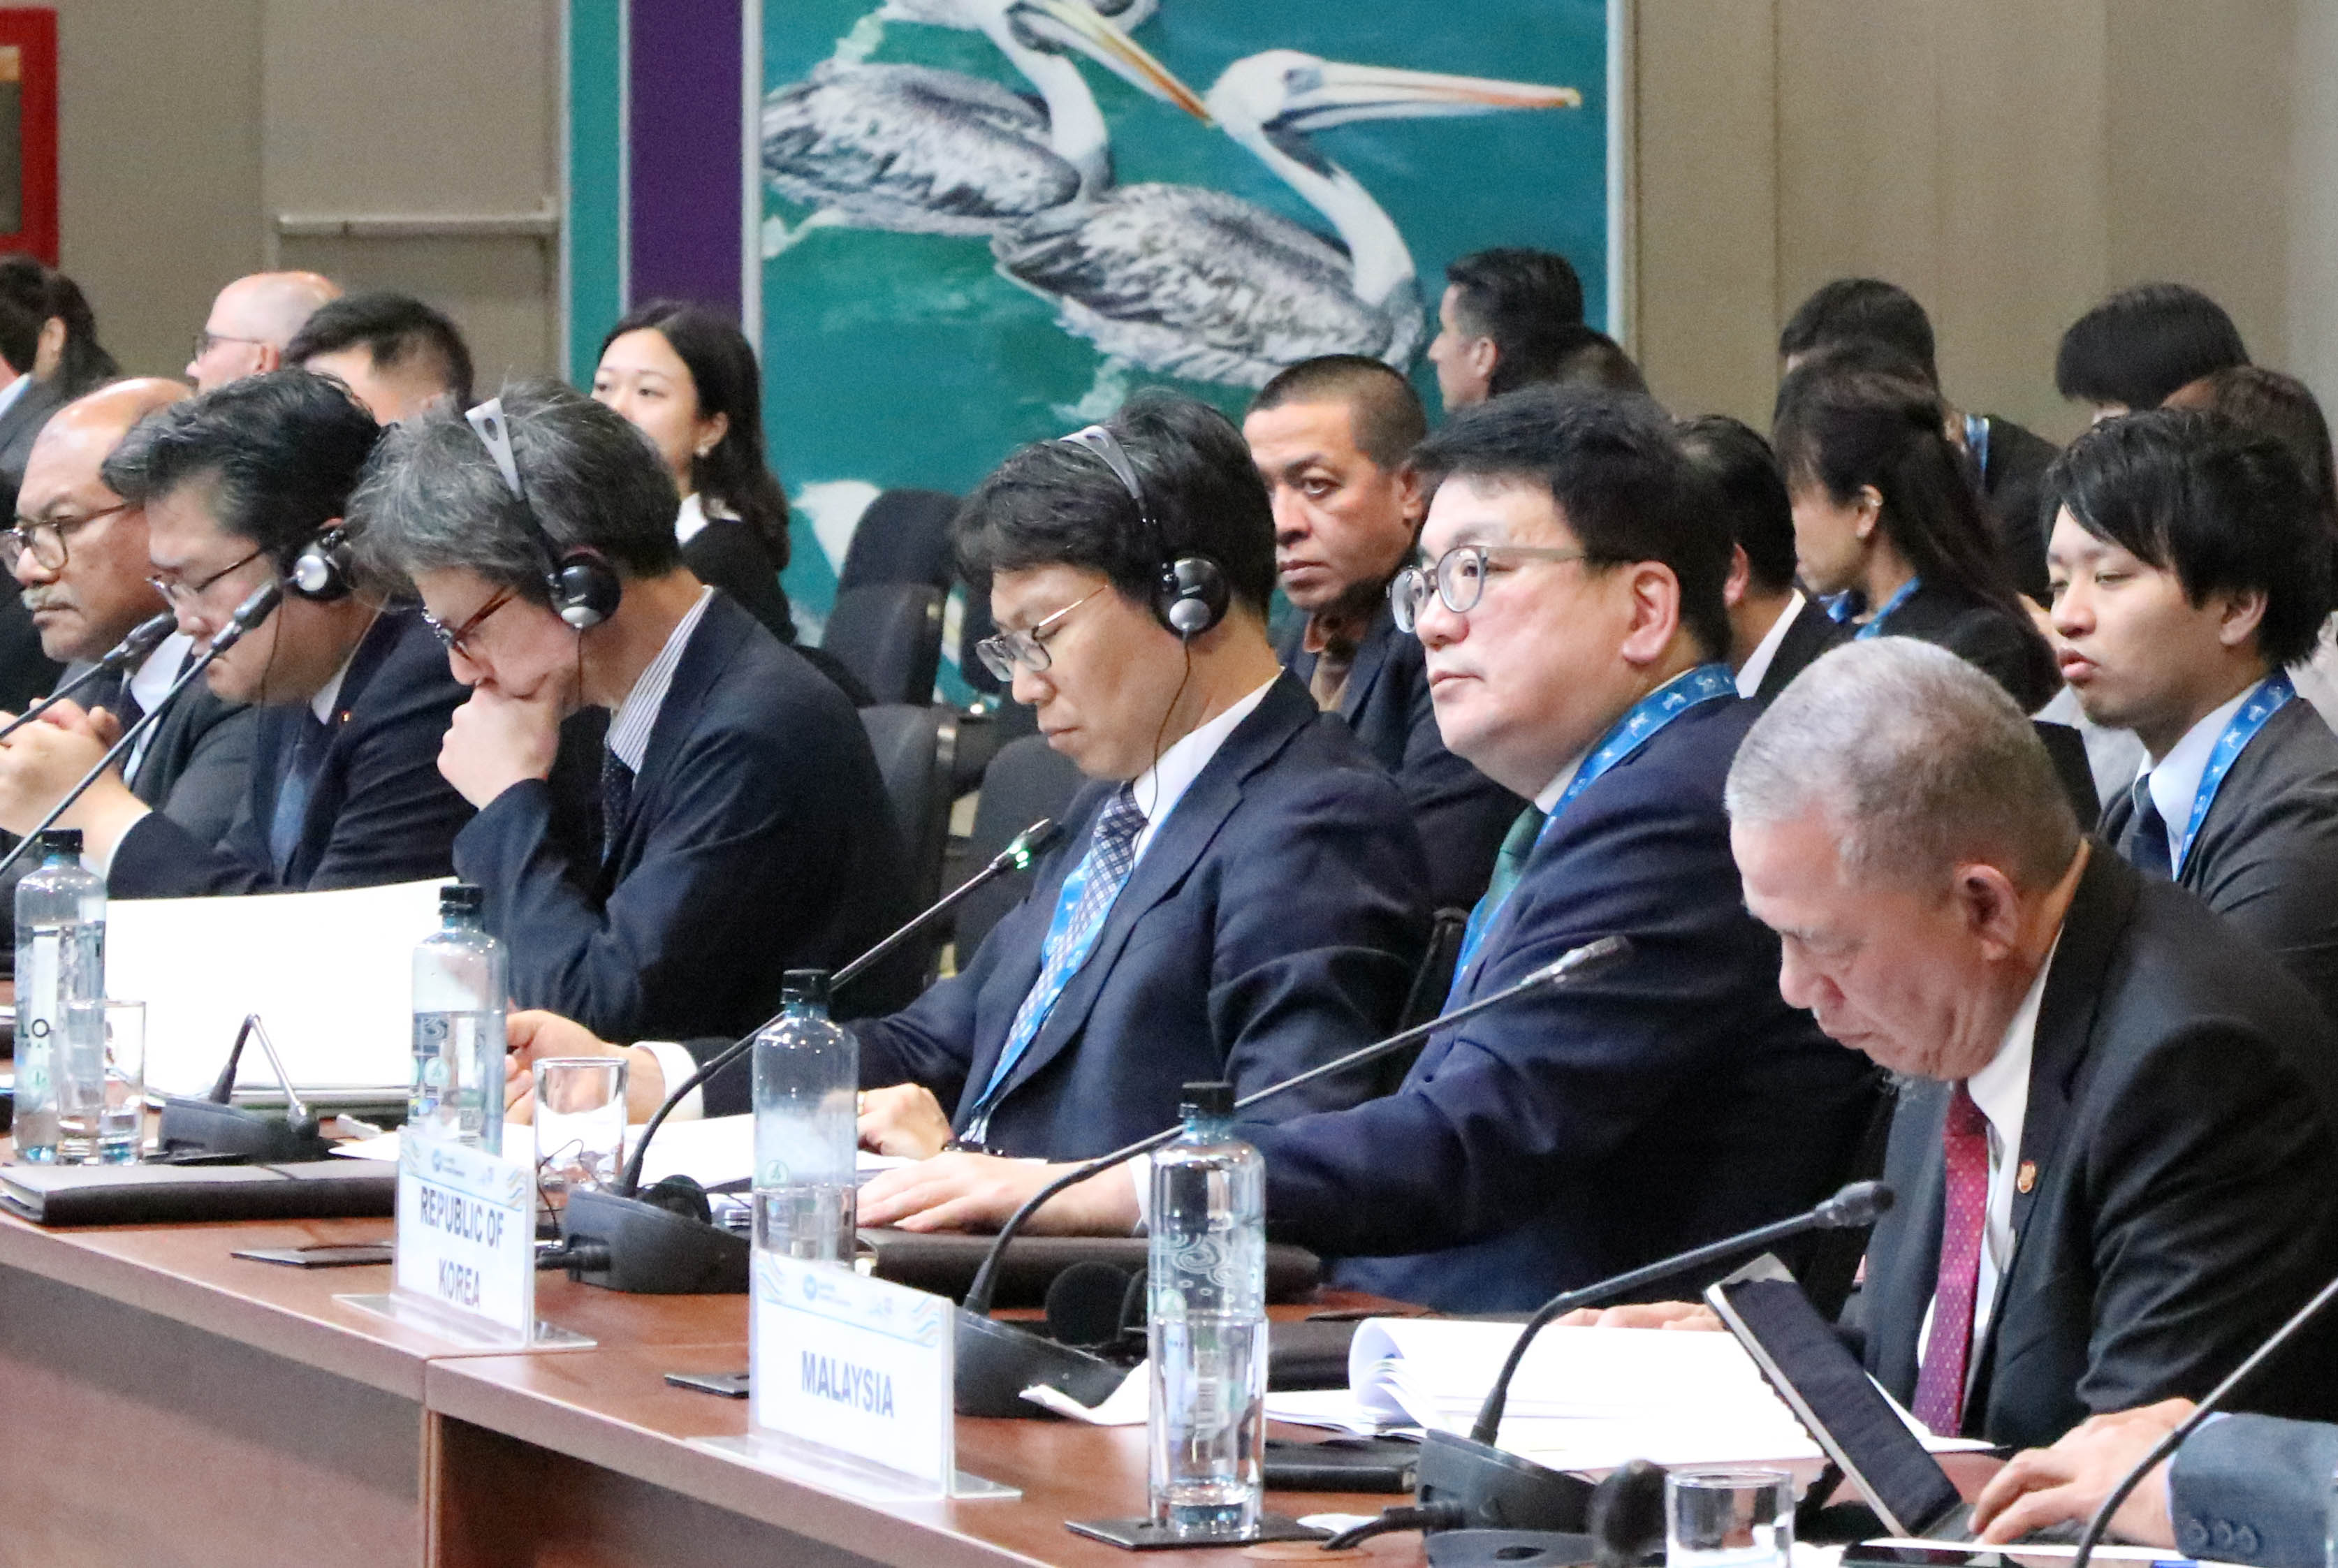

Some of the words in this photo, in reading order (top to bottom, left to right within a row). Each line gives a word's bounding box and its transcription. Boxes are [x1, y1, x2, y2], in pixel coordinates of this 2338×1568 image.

[421, 1186, 482, 1243] REPUBLIC
[488, 1209, 504, 1248] OF
[439, 1258, 481, 1308] KOREA
[802, 1350, 894, 1419] MALAYSIA
